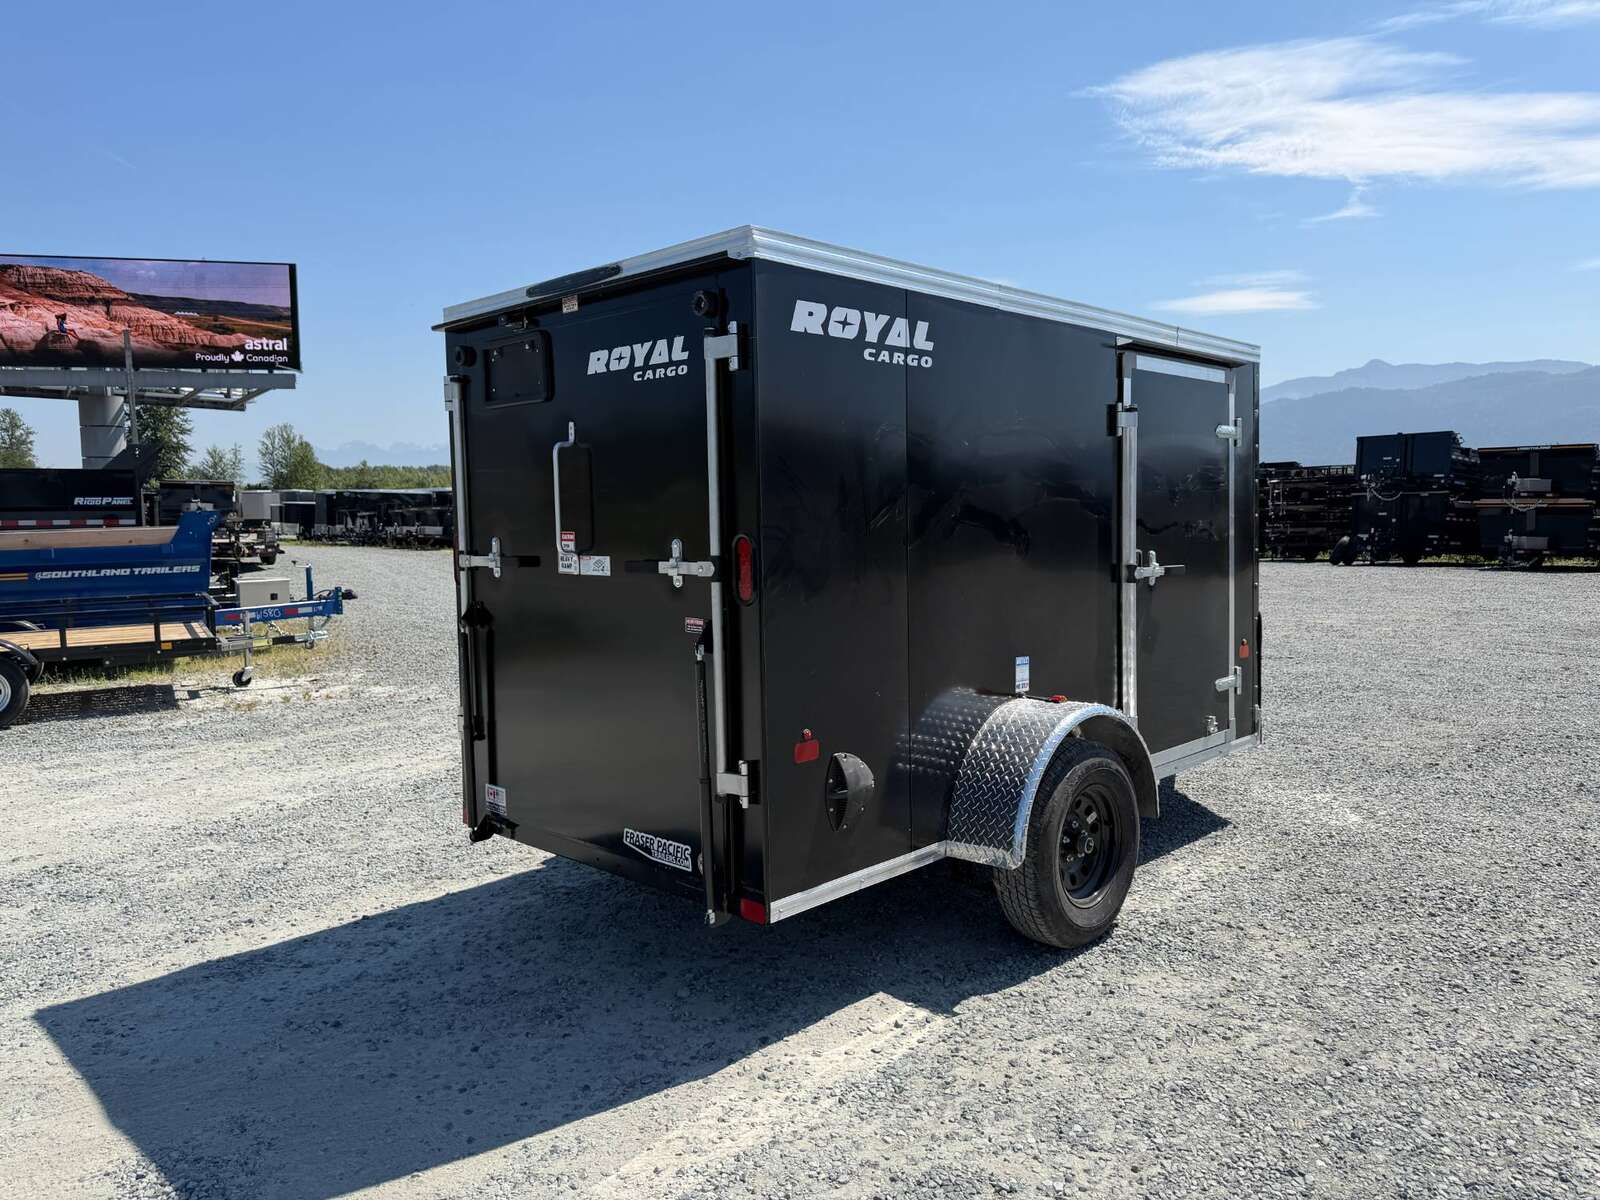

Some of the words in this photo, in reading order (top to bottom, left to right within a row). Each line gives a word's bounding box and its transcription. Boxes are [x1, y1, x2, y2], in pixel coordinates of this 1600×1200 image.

[790, 300, 934, 351] ROYAL
[244, 337, 288, 351] astral
[195, 352, 230, 364] Proudly
[587, 336, 689, 375] ROYAL
[863, 348, 933, 368] CARGO
[633, 364, 688, 382] CARGO
[102, 497, 134, 505] PANEL
[40, 568, 131, 579] SOUTHLAND
[132, 565, 201, 576] TRAILERS
[625, 831, 655, 851] FRASER
[656, 839, 691, 862] PACIFIC
